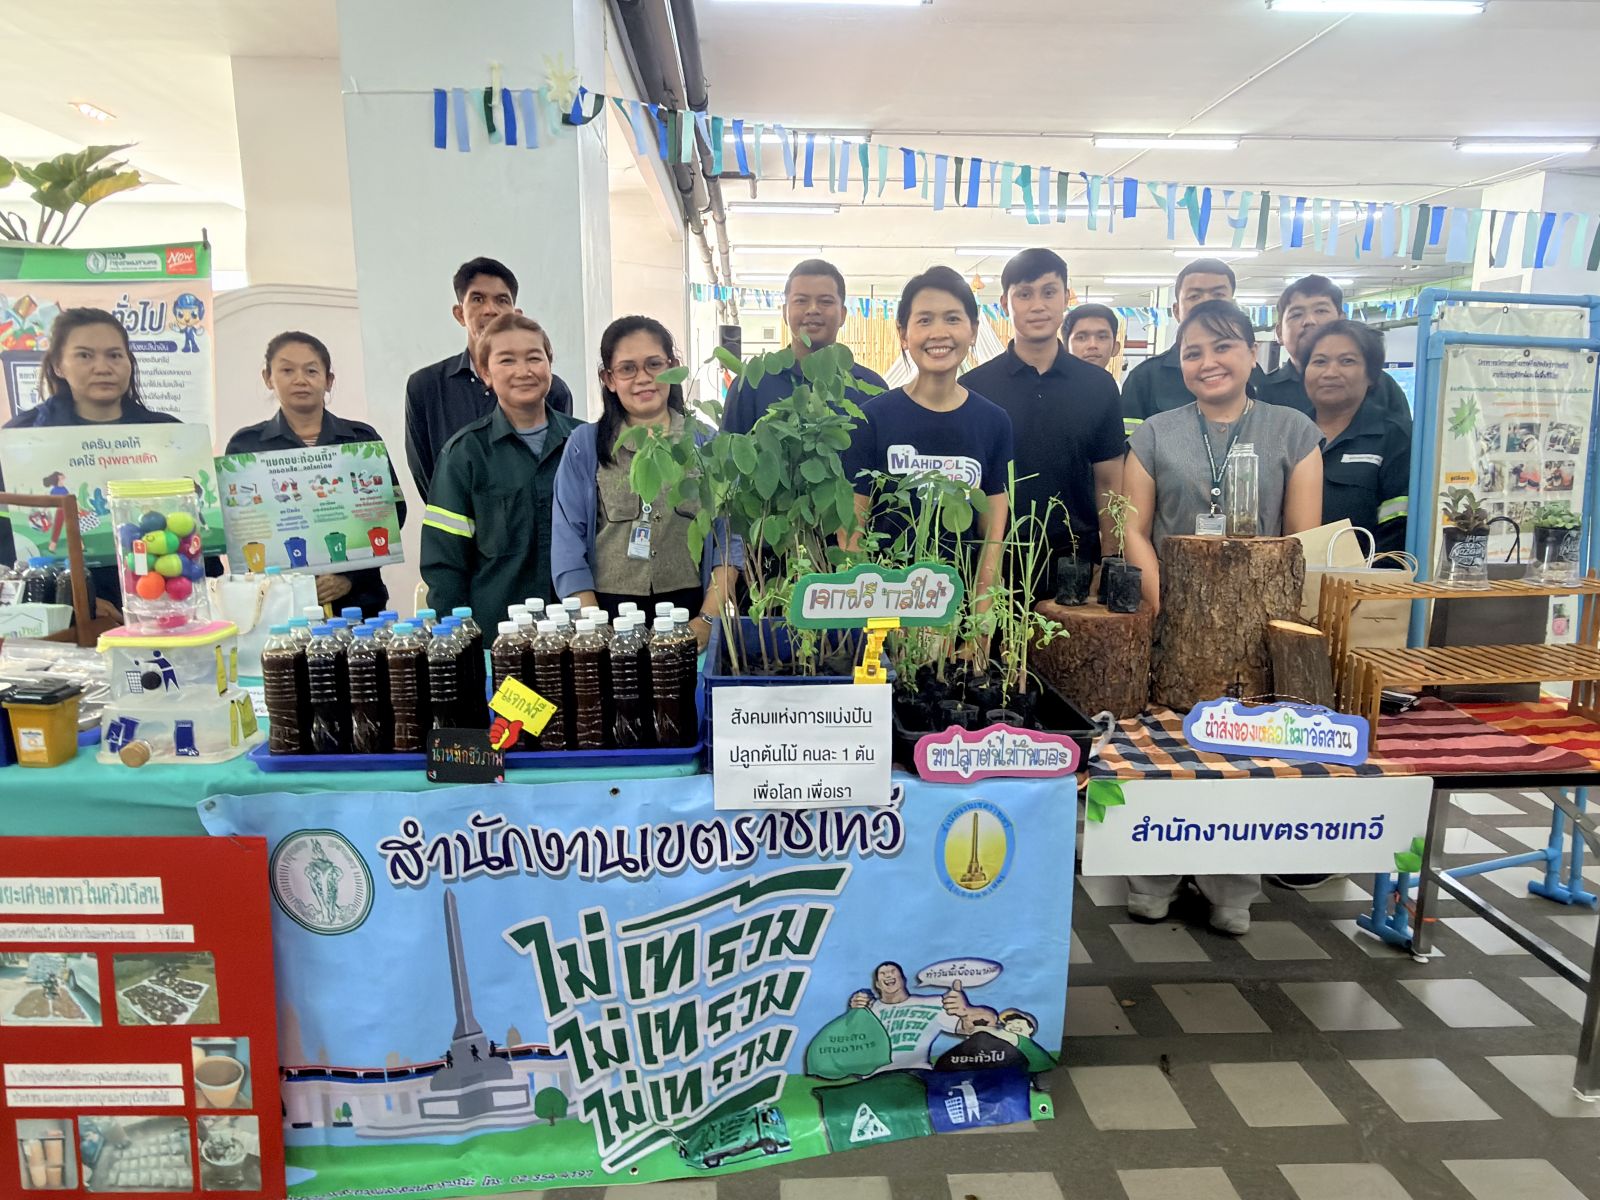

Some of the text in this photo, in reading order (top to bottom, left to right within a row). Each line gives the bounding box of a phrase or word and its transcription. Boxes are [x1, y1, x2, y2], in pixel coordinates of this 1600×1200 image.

[115, 436, 141, 449] ลดให้
[69, 452, 158, 469] ลดใช้ ถุงพลาสติก
[731, 706, 872, 725] สังคมแห่งการแบ่งปัน
[730, 744, 875, 768] ปลูกต้นไม้ คนละ 1 ต้น
[753, 779, 852, 800] เพื่อโลก เพื่อเรา
[1131, 814, 1385, 842] สำนักงานเขตราชเทวี
[951, 1050, 1005, 1064] ขยะทั่วไป
